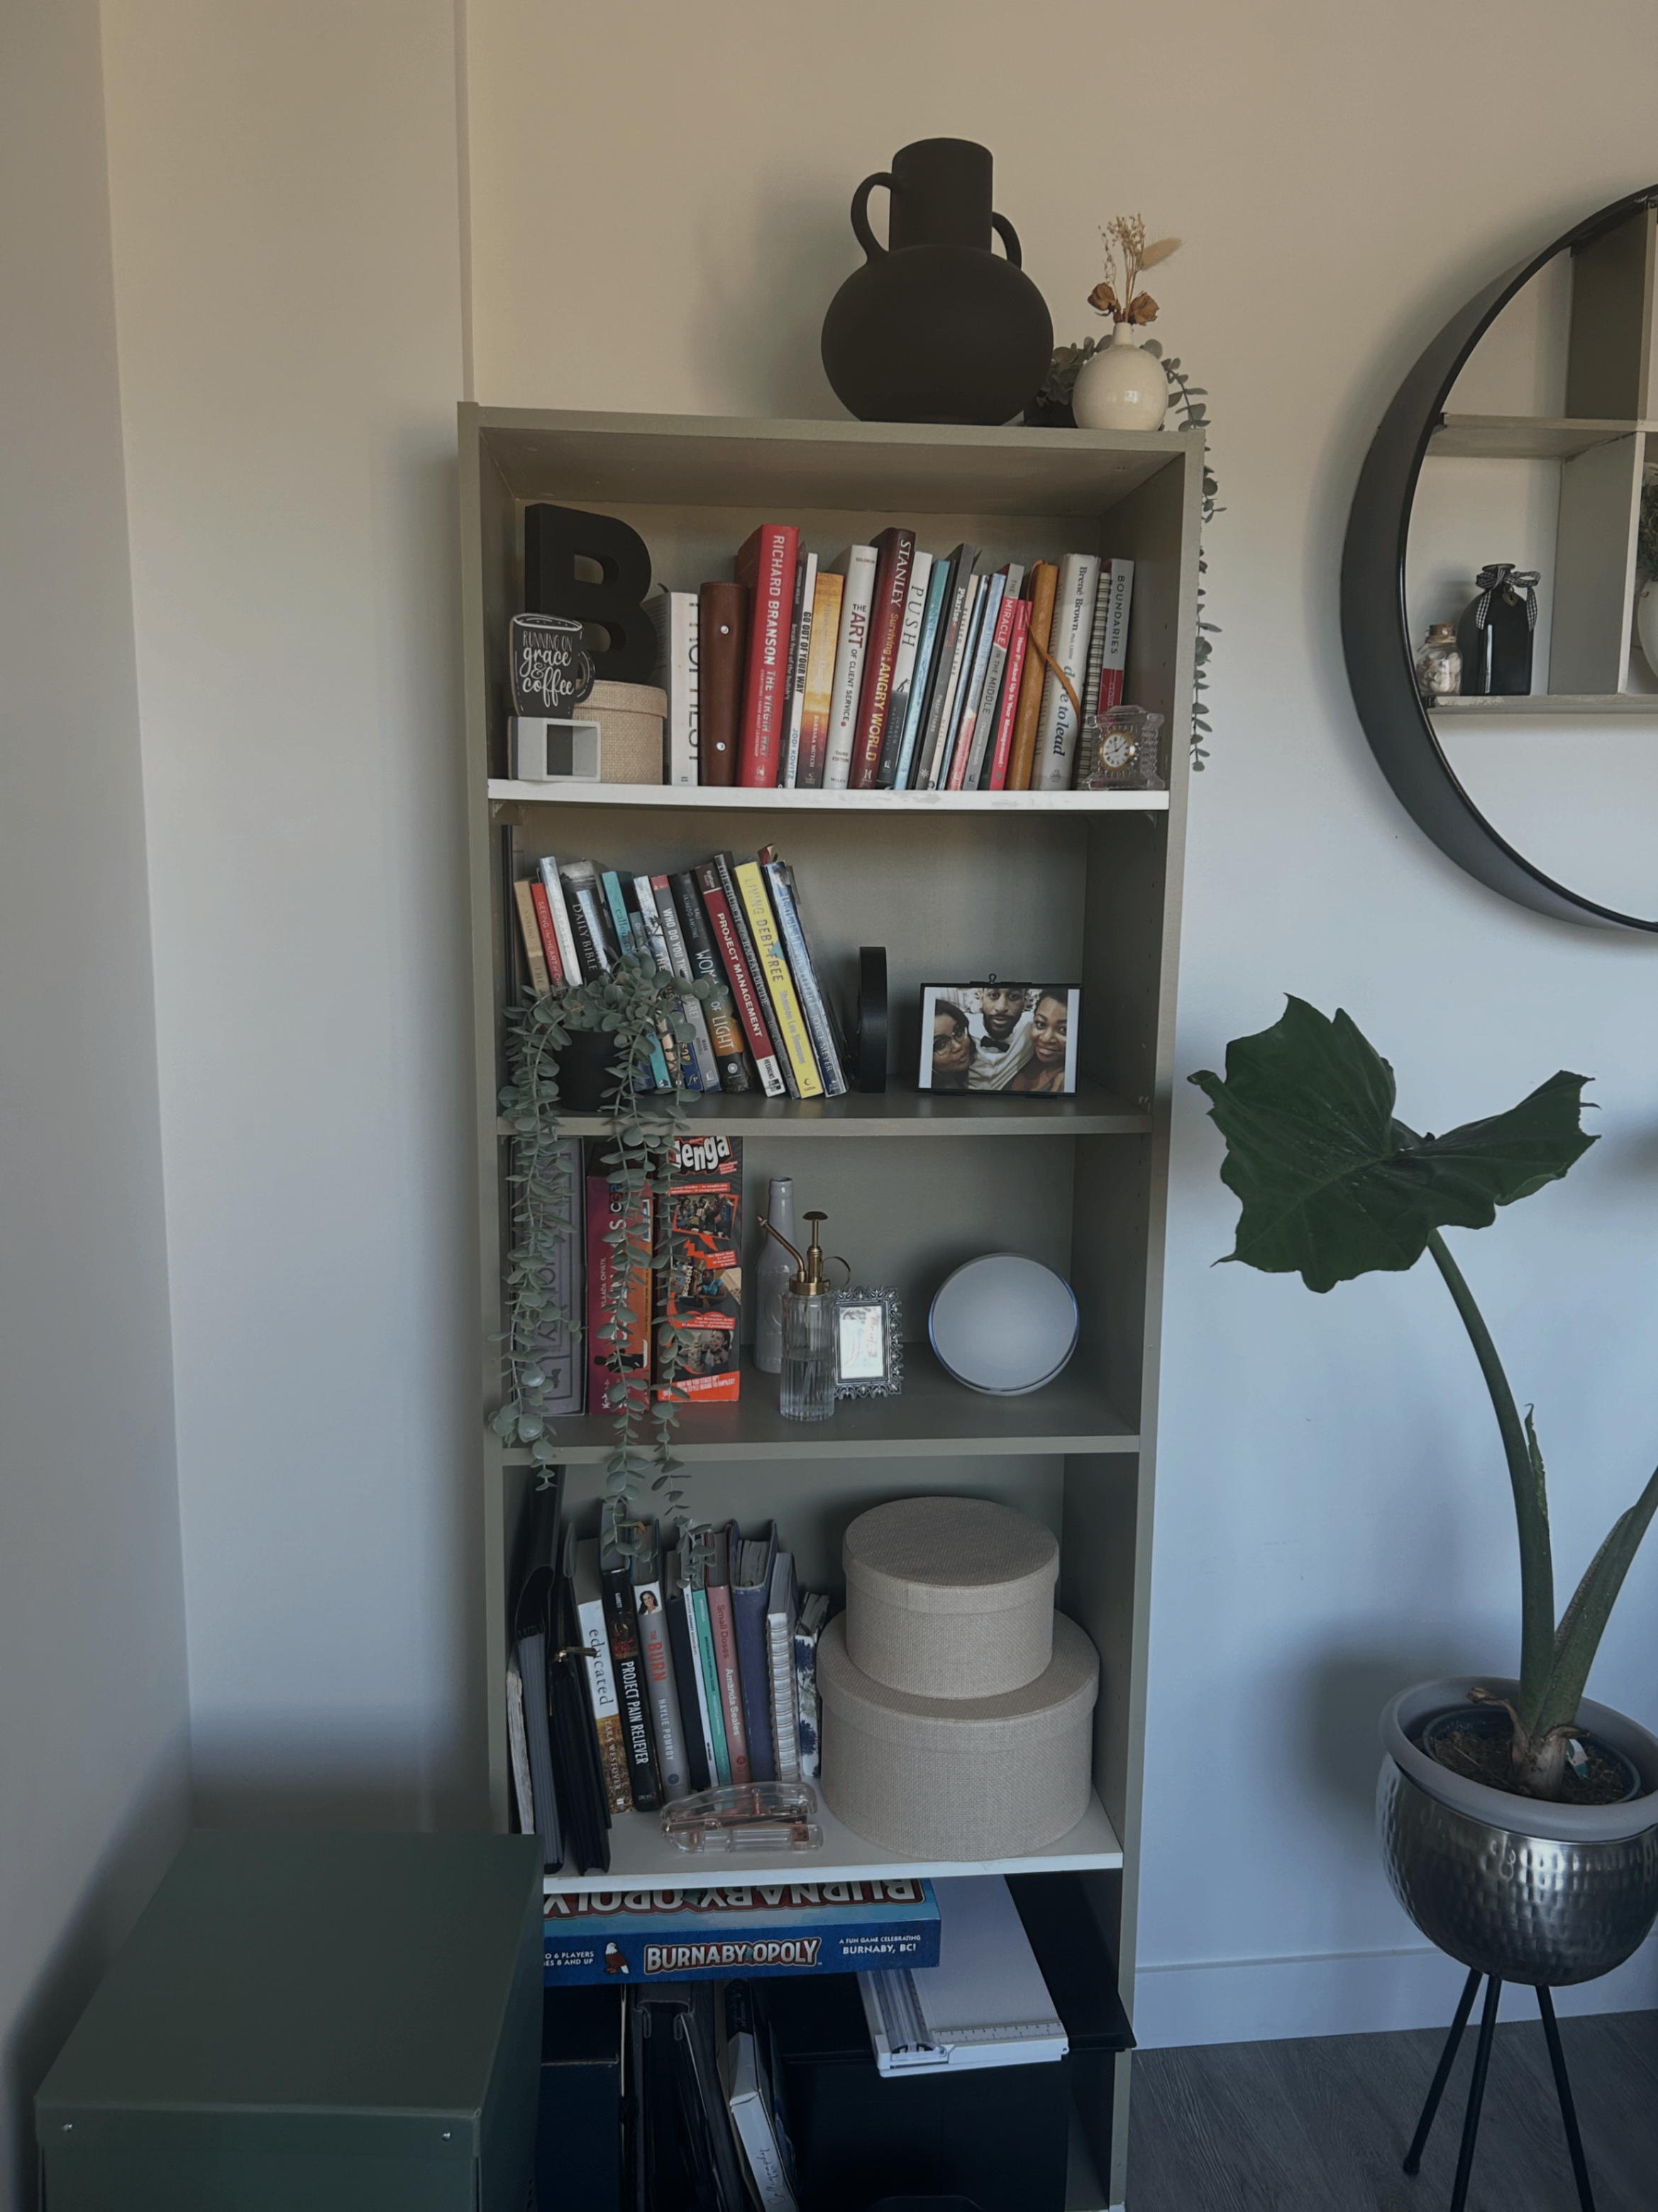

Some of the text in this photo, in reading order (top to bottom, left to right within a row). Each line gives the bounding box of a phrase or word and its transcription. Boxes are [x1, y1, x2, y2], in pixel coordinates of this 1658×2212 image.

[890, 539, 911, 609] STANLEY
[1076, 565, 1088, 596] Brené
[763, 535, 785, 665] RICHARD BRANSON
[853, 604, 867, 613] THE
[902, 585, 924, 648] PUSH
[1111, 575, 1125, 655] BOUNDARIES
[522, 630, 573, 652] RUNNING ON
[848, 612, 866, 648] ART
[884, 613, 899, 656] Surviving
[997, 599, 1013, 644] MIRACLE
[519, 646, 572, 678] grace
[795, 612, 812, 694] GO OUT OF YOUR WAY
[995, 650, 1001, 659] IN
[1015, 637, 1024, 655] How
[531, 662, 546, 679] &
[766, 670, 776, 691] THE
[843, 649, 857, 721] OF CLIENT SERVICE
[992, 659, 1000, 674] THE
[522, 668, 575, 707] coffee
[874, 662, 891, 711] ANGRY
[983, 677, 997, 716] MIDDLE
[1008, 682, 1017, 693] Up
[762, 695, 775, 732] VIRGIN
[1005, 702, 1013, 719] Your
[1058, 706, 1068, 720] to
[866, 713, 883, 762] WORLD
[1053, 721, 1070, 757] lead
[787, 750, 796, 780] KOVITZ
[538, 901, 548, 927] SEEING
[548, 940, 557, 964] HEART
[663, 908, 675, 927] WHO
[668, 929, 678, 941] DO
[745, 878, 784, 982] LIVING DEBT-FREE
[573, 904, 597, 971] DAILY BIBLE
[672, 941, 683, 958] YOU
[724, 884, 743, 923] CHURCH
[753, 975, 769, 1006] DIVIDE
[534, 967, 544, 985] THE
[656, 952, 666, 972] THE
[717, 913, 763, 1037] PROJECT MANAGEMENT
[686, 1001, 699, 1019] ARE?
[711, 1001, 734, 1049] OF LIGHT
[811, 1014, 834, 1072] JOYCE MEYER
[674, 1136, 730, 1171] Jenga
[717, 1604, 729, 1659] Small Doses
[589, 1629, 614, 1705] educated
[647, 1642, 666, 1682] BURN
[621, 1661, 648, 1764] PROJECT PAIN RELIEVER
[725, 1668, 740, 1736] Amanda Seales
[658, 1698, 675, 1761] HAYLIE POMROY
[609, 1744, 621, 1790] WESTOVER
[647, 1940, 818, 1972] BURNABY OPOLY
[842, 1943, 917, 1954] BURNABY, BC!
